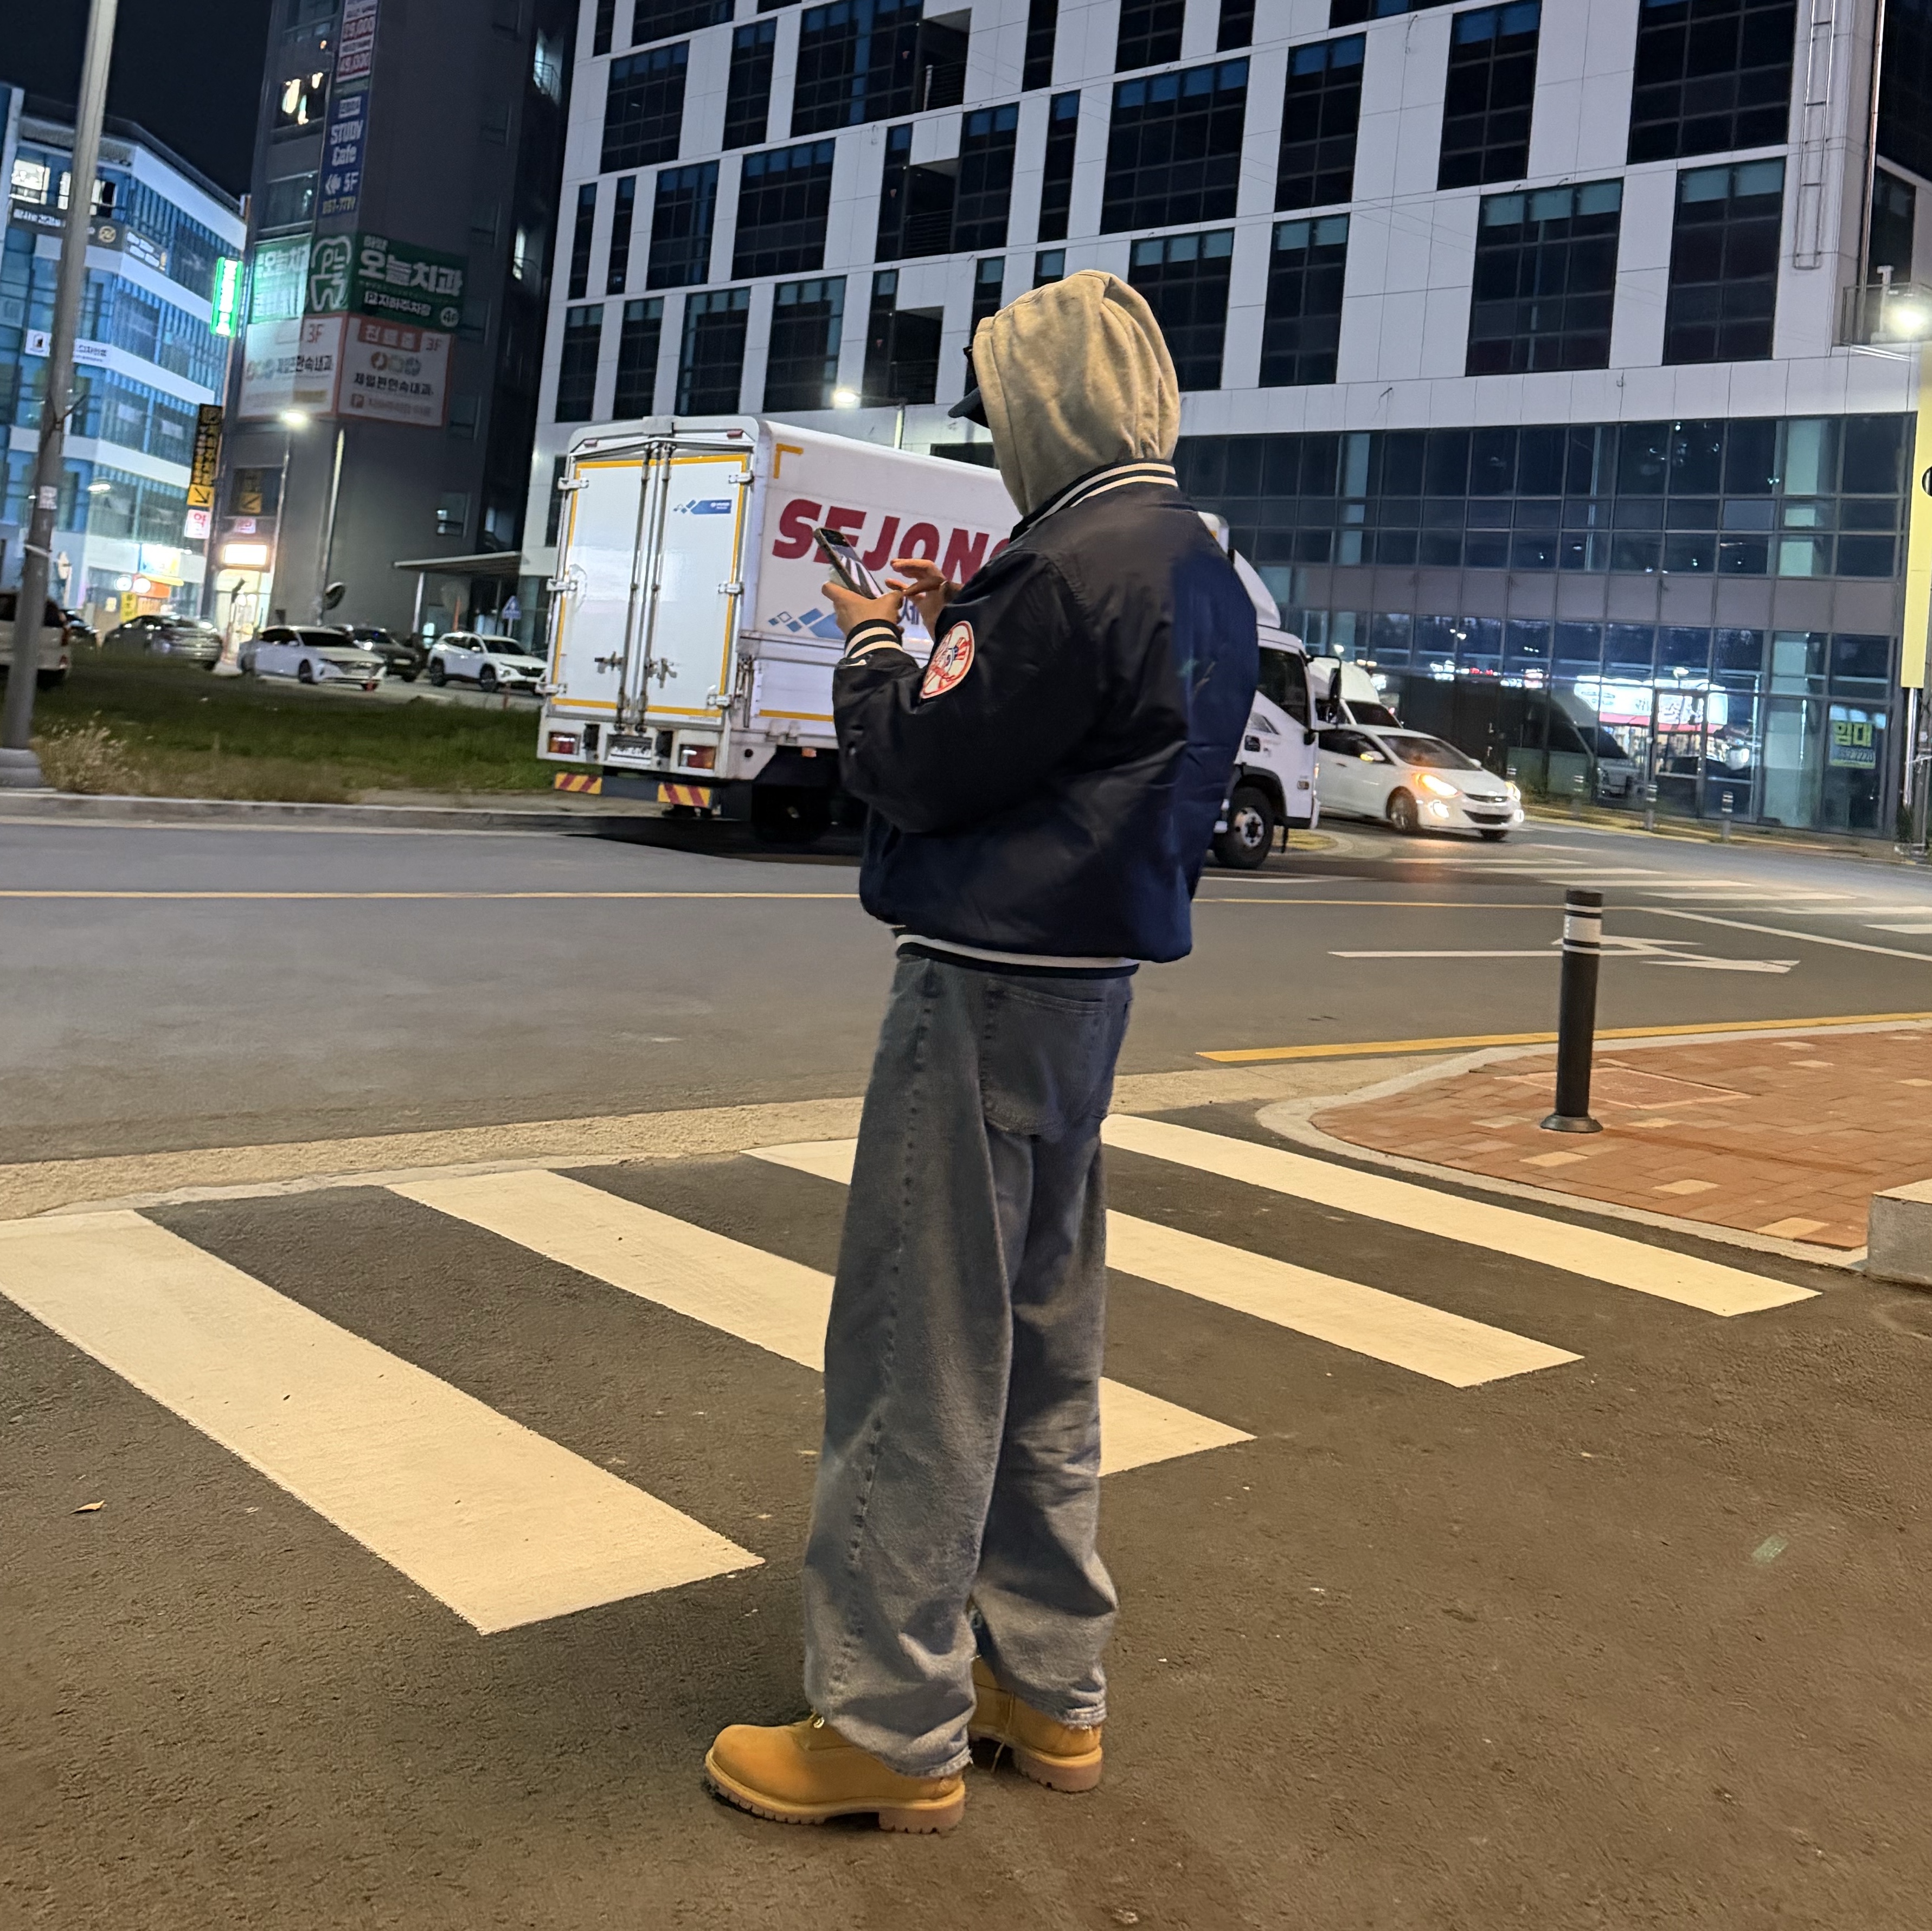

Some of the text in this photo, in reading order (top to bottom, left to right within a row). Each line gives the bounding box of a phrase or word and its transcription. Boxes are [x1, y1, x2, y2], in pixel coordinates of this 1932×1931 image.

[330, 120, 363, 145] STUDY
[332, 144, 357, 166] Cafe
[358, 249, 463, 297] 오늘치과
[307, 324, 324, 344] 3F
[426, 337, 441, 351] 3F
[772, 499, 1011, 584] SEJON
[1833, 722, 1873, 747] 임대
